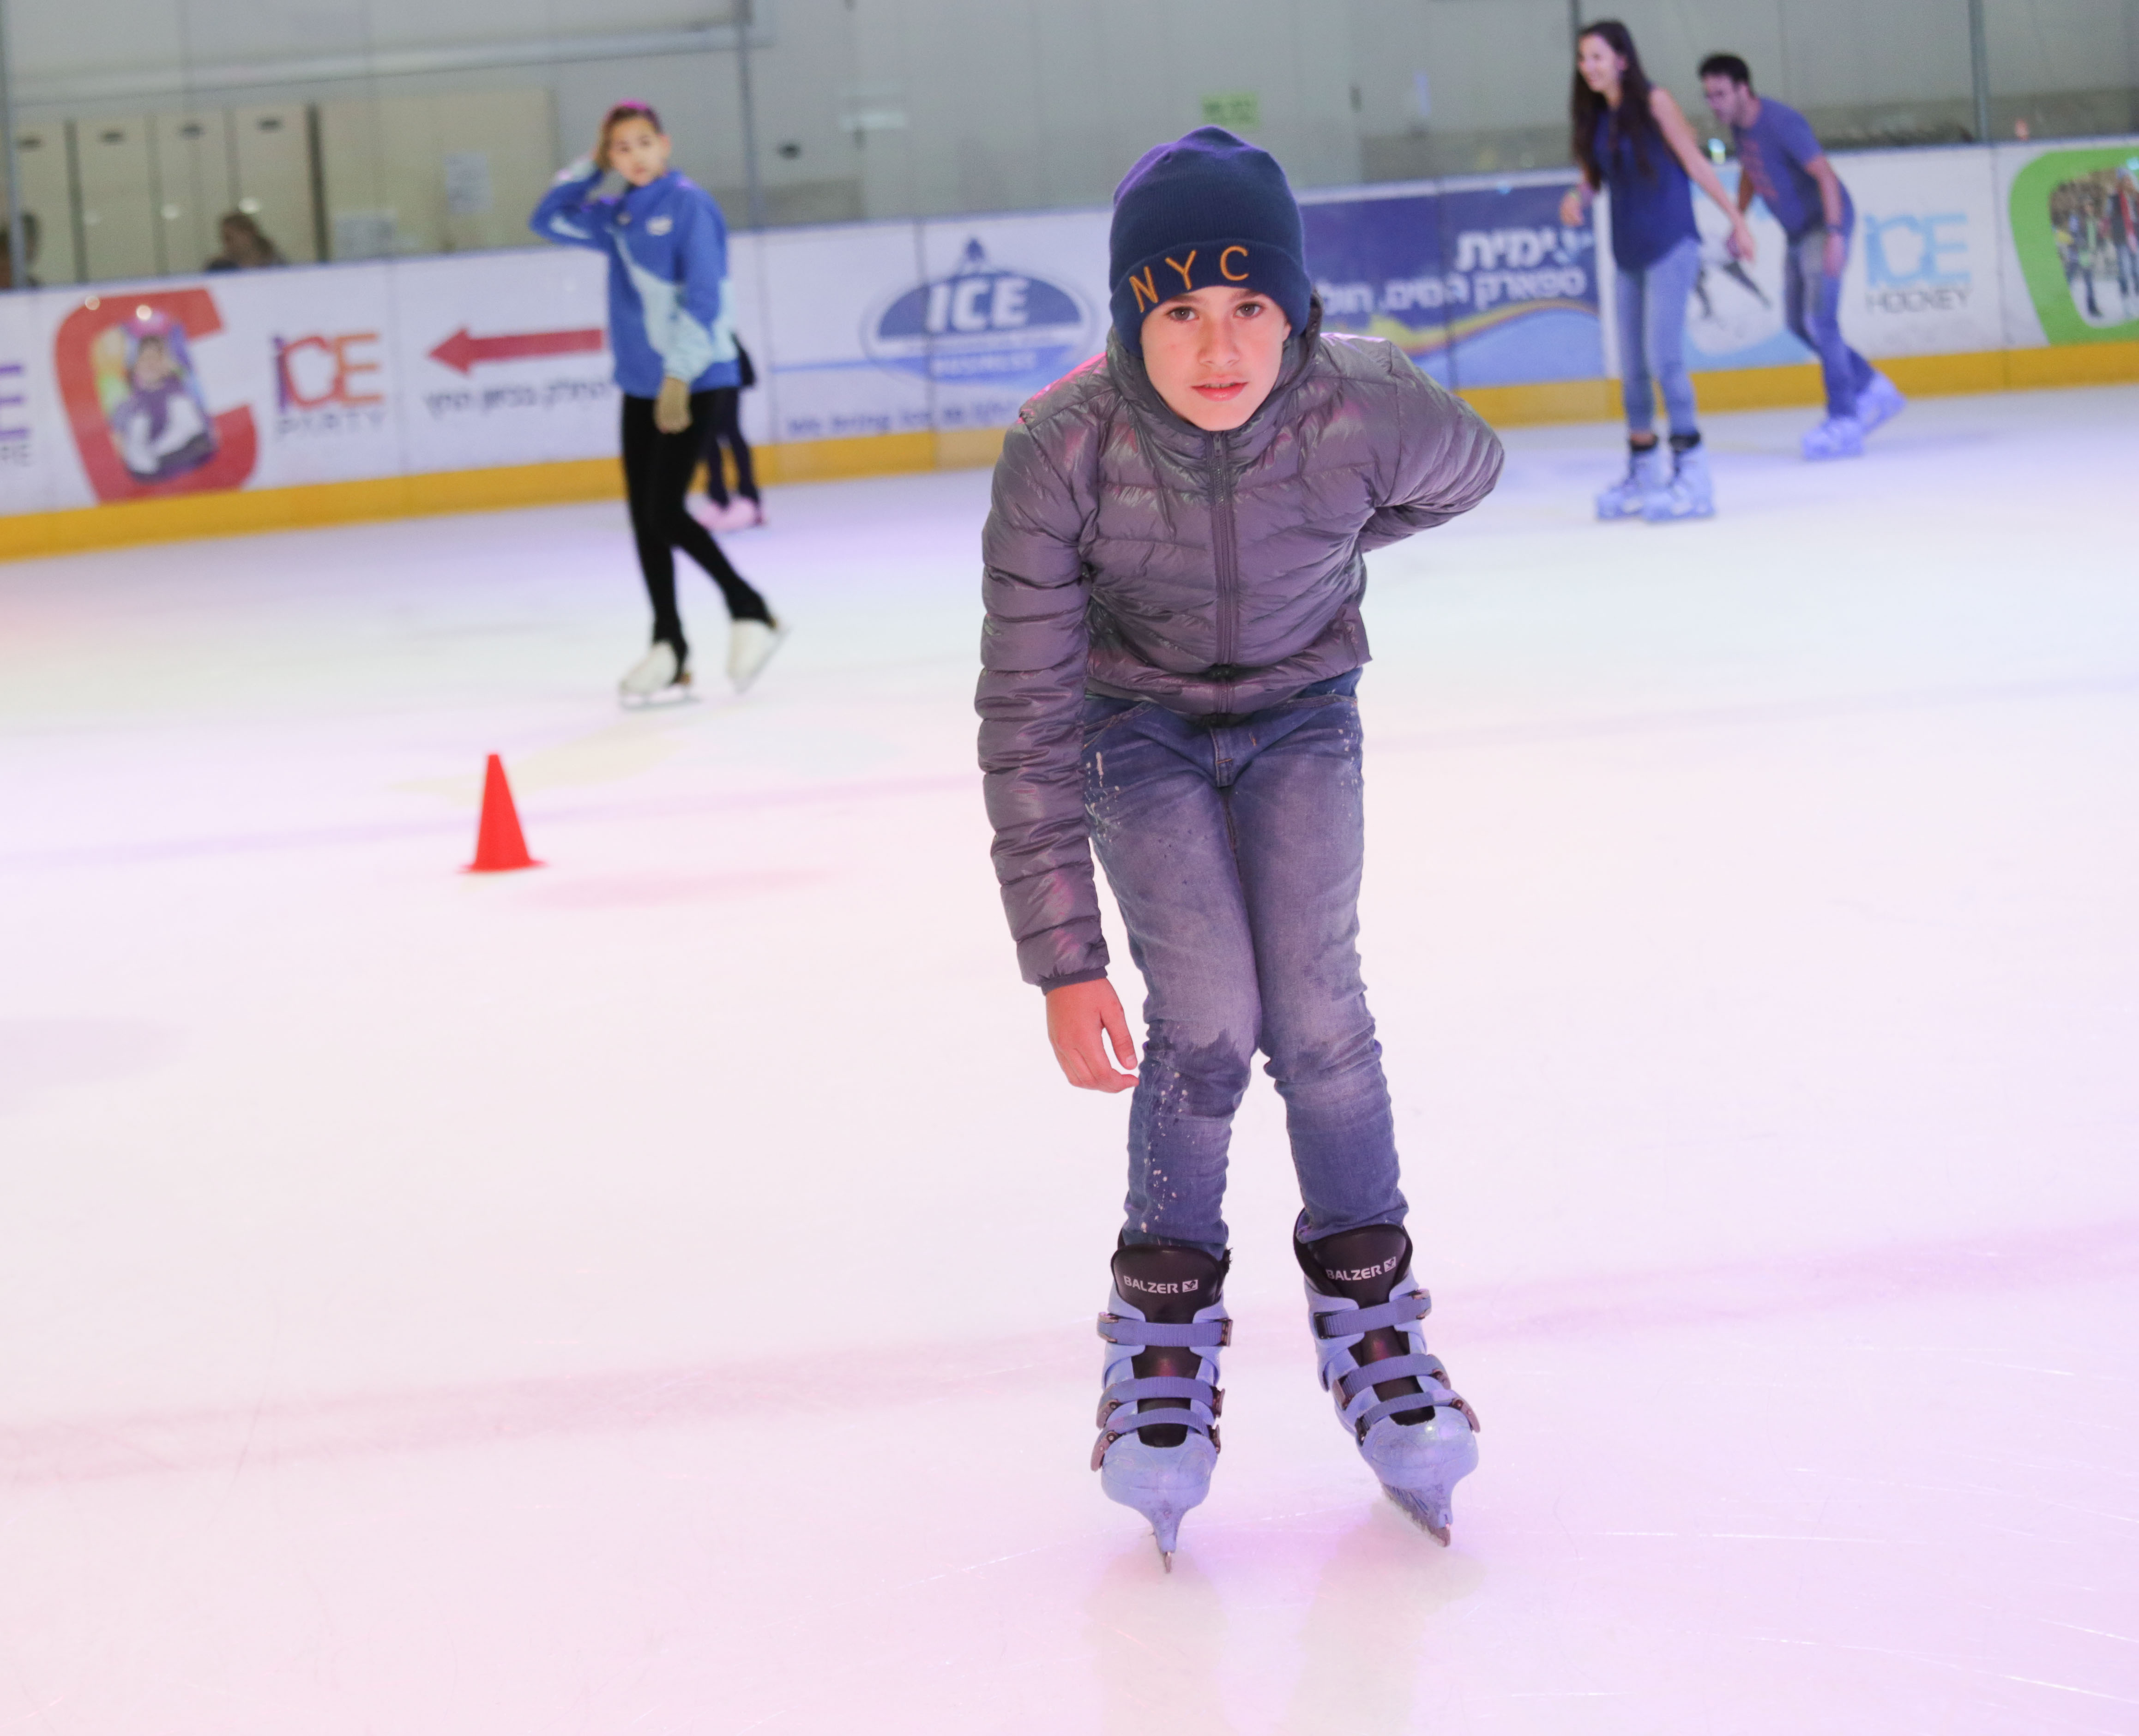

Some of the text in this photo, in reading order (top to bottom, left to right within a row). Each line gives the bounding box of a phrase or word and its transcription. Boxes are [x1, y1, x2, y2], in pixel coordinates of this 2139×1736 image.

[1129, 245, 1249, 313] NYC
[1864, 214, 1970, 287] ICE
[925, 277, 1029, 333] ICE
[271, 331, 384, 414] ICE
[1123, 1275, 1179, 1294] BALZER
[1326, 1265, 1382, 1281] BALZER
